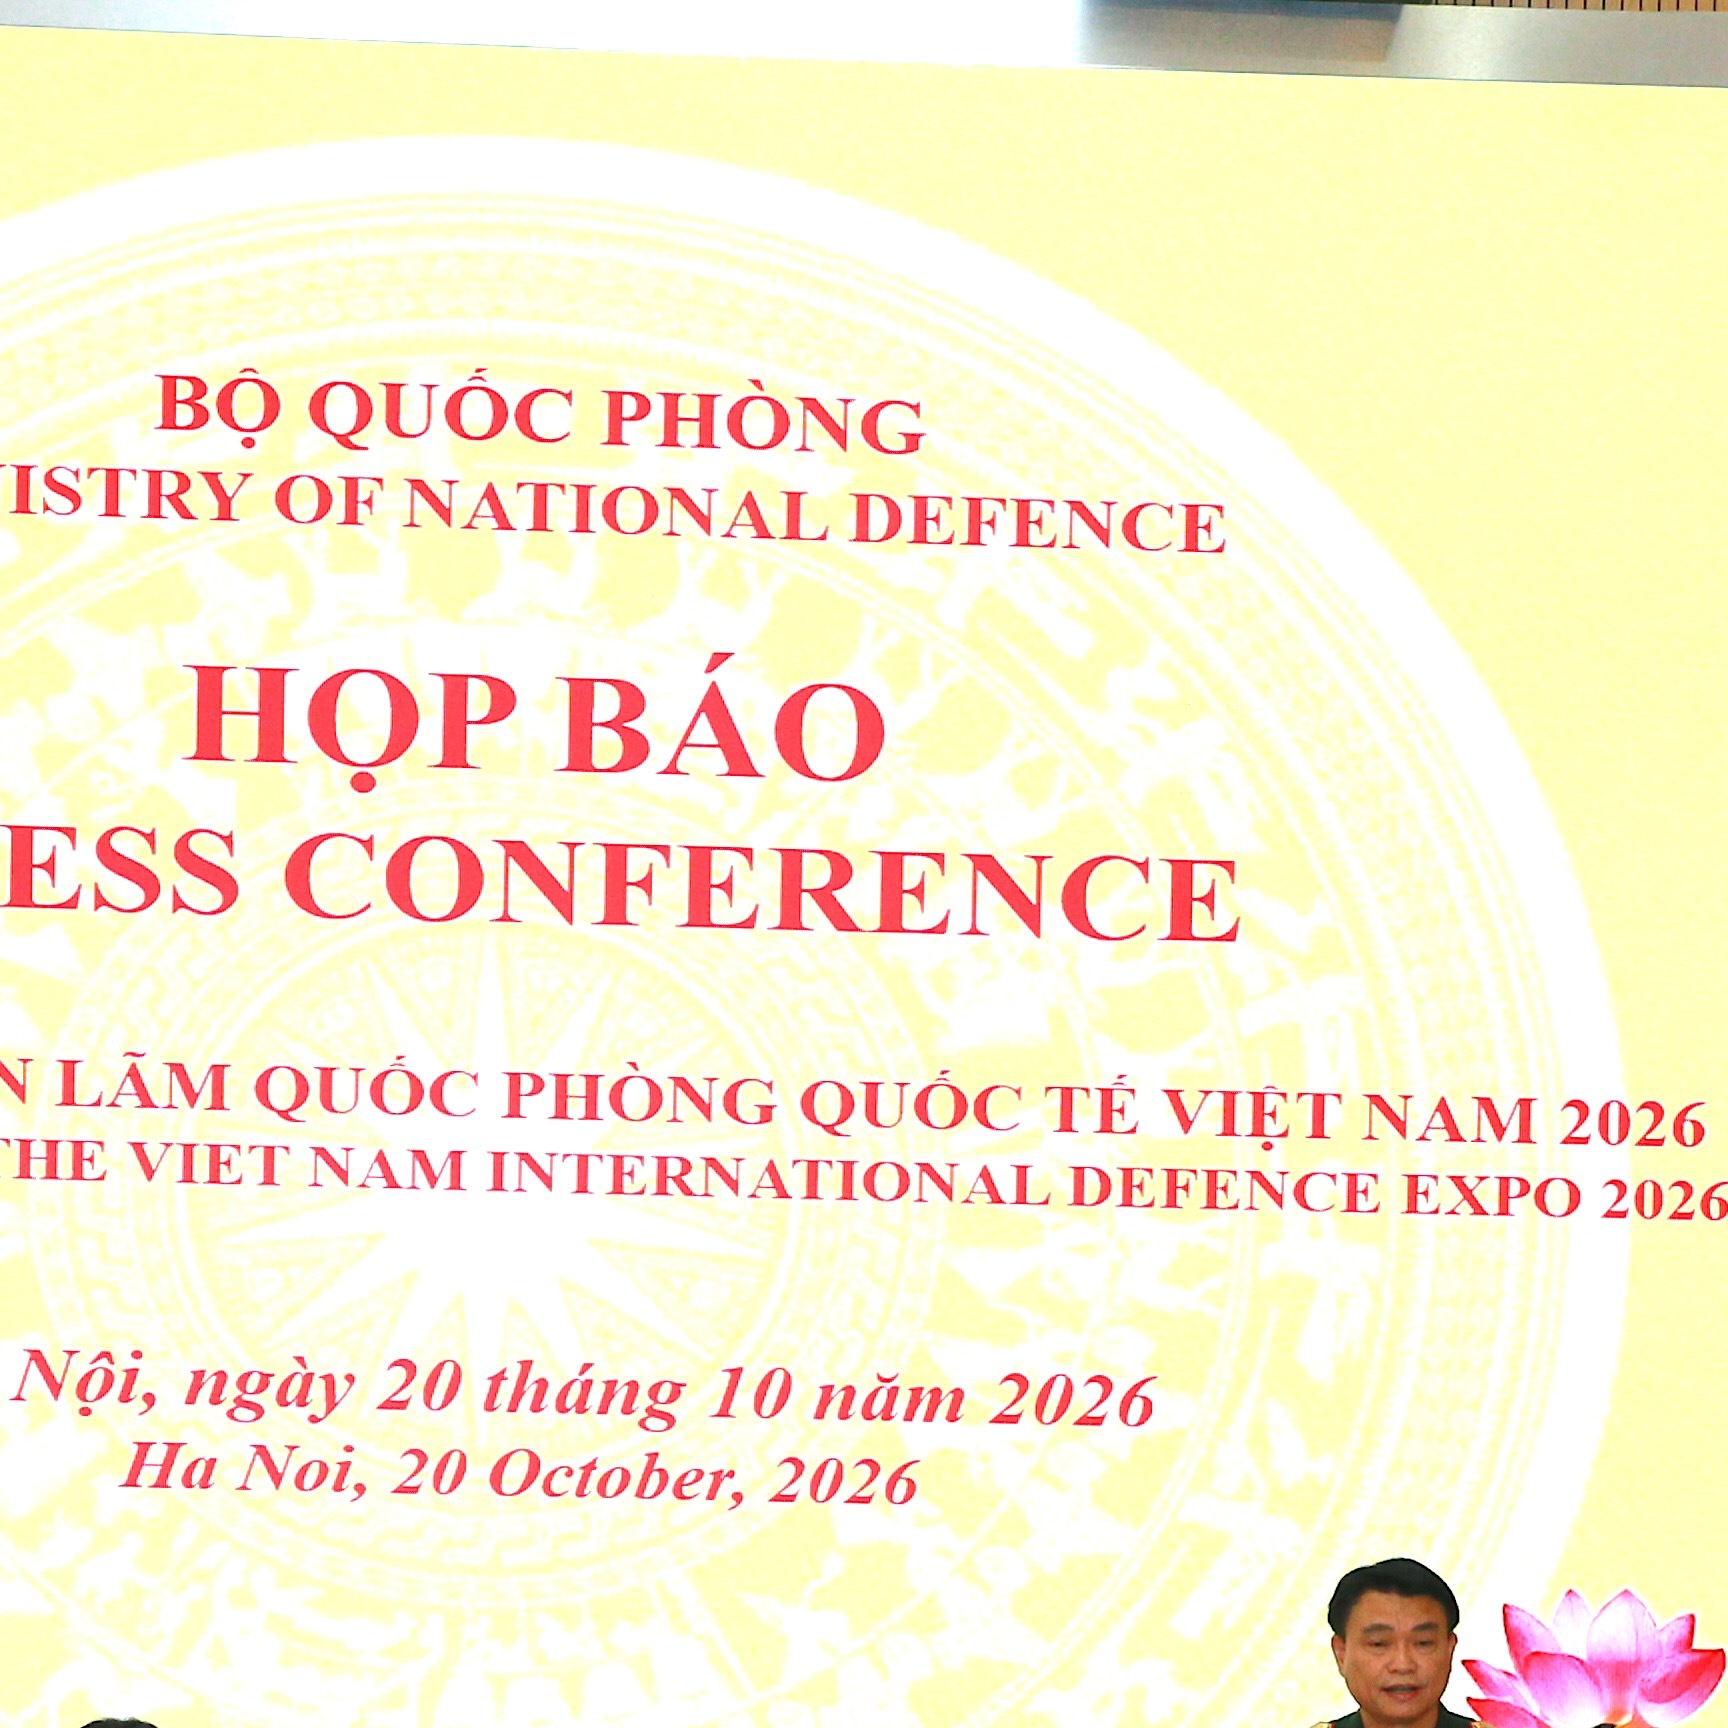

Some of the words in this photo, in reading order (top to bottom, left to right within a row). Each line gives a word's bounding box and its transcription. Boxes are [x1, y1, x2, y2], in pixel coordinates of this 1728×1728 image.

[155, 366, 282, 451] BỘ
[307, 366, 574, 452] QUỐC
[601, 377, 926, 456] PHÒNG
[273, 473, 385, 527] OF
[404, 476, 829, 543] NATIONAL
[850, 492, 1227, 555] DEFENCE
[183, 663, 519, 795] HỌP
[558, 650, 887, 784] BÁO
[283, 831, 1242, 944] CONFERENCE
[55, 1050, 231, 1112] LÃM
[253, 1053, 480, 1124] QUỐC
[501, 1060, 777, 1126] PHÒNG
[799, 1068, 1023, 1138] QUỐC
[1044, 1073, 1140, 1136] TẾ
[1161, 1084, 1344, 1153] VIỆT
[1362, 1092, 1538, 1146] NAM
[1559, 1097, 1707, 1149] 2026
[127, 1140, 292, 1188] VIET
[308, 1145, 466, 1192] NAM
[488, 1150, 1052, 1207] INTERNATIONAL
[1068, 1164, 1381, 1215] DEFENCE
[1401, 1172, 1583, 1219] EXPO
[9, 1347, 158, 1418] Nội,
[183, 1354, 357, 1426] ngày
[375, 1357, 464, 1412] 20
[482, 1358, 688, 1434] tháng
[711, 1365, 794, 1420] 10
[812, 1372, 966, 1425] năm
[987, 1371, 1159, 1429] 2026
[119, 1440, 219, 1491] Ha
[235, 1443, 368, 1503] Noi,
[390, 1447, 468, 1496] 20
[488, 1447, 745, 1512] October,
[767, 1455, 921, 1506] 2026
